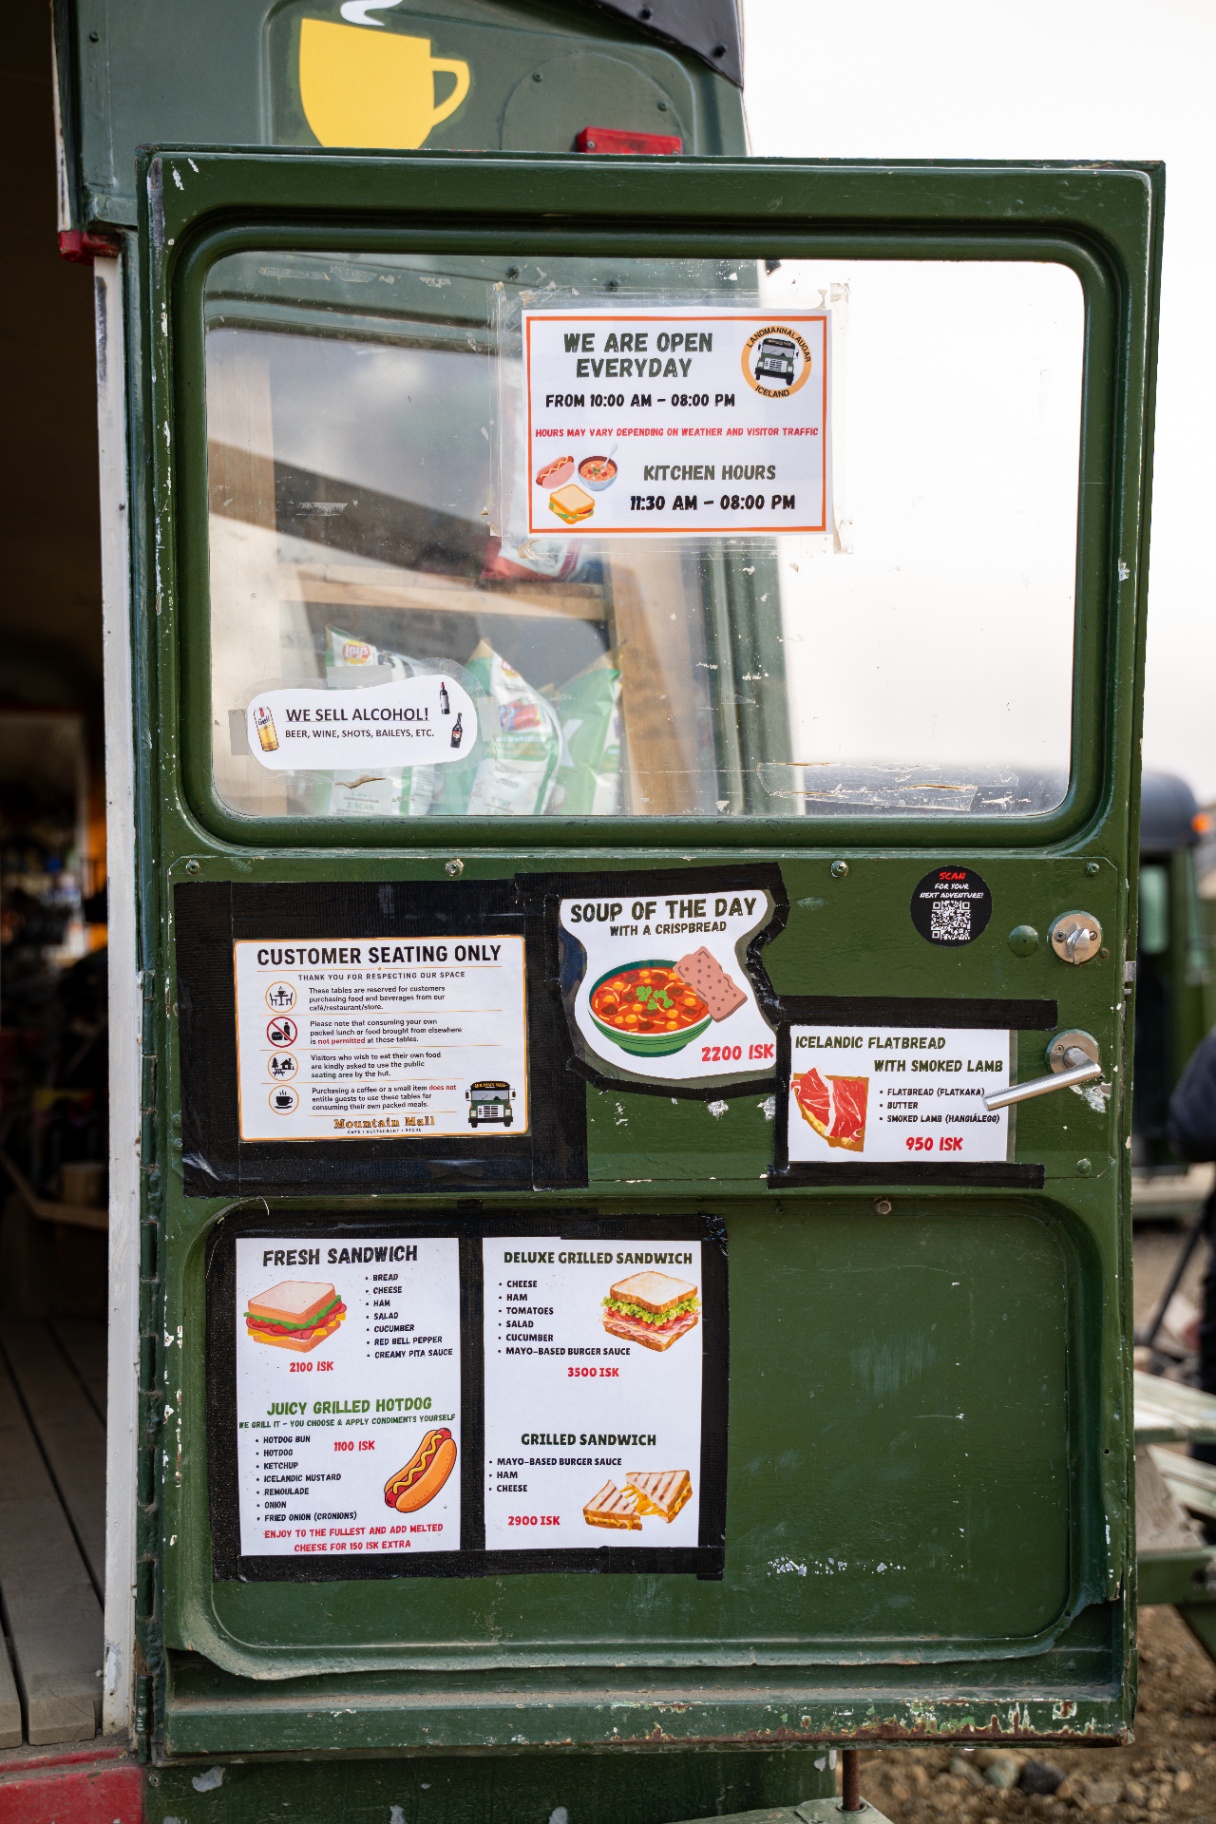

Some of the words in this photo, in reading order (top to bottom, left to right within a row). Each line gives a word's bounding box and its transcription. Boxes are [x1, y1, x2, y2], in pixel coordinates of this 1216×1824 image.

[564, 333, 595, 353] WE
[604, 333, 648, 352] ARE
[657, 333, 713, 352] OPEN
[747, 326, 811, 363] LANDMANNALAUGAR
[576, 358, 692, 378] EVERYDAY
[755, 385, 790, 398] ICELAND
[546, 394, 585, 408] FROM
[590, 394, 625, 407] 10:00
[630, 394, 652, 407] AM
[671, 394, 709, 407] 08:00
[715, 394, 735, 407] PM
[535, 429, 564, 437] HOURS
[567, 429, 586, 437] MAY
[590, 428, 613, 436] VARY
[616, 428, 664, 436] DEPENDING
[667, 428, 679, 436] ON
[682, 428, 723, 436] WEATHER
[726, 428, 744, 436] AND
[747, 428, 779, 436] VISITOR
[782, 427, 819, 436] TRAFFIC
[644, 465, 715, 481] KITCHEN
[722, 465, 776, 480] HOURS
[631, 496, 666, 510] 11:30
[672, 495, 697, 510] AM
[720, 495, 765, 510] 08:00
[771, 495, 795, 510] PM
[286, 709, 311, 722] WE
[316, 709, 348, 722] SELL
[352, 708, 428, 721] ALCOHOL!
[286, 730, 310, 739] BEER,
[312, 730, 340, 738] WINE,
[342, 730, 373, 738] SHOTS,
[376, 729, 413, 737] BAILEYS,
[416, 729, 434, 737] ETC.
[939, 872, 966, 880] SCAN
[571, 903, 623, 923] SOUP
[632, 901, 657, 920] OF
[665, 899, 706, 919] THE
[715, 898, 757, 917] DAY
[610, 925, 638, 936] WITH
[643, 925, 651, 935] A
[655, 921, 727, 934] CRISPBREAD
[257, 948, 361, 965] CUSTOMER
[368, 946, 448, 963] SEATING
[455, 945, 501, 962] ONLY
[366, 972, 417, 980] RESPECTING
[796, 1036, 863, 1048] ICELANDIC
[868, 1037, 946, 1049] FLATBREAD
[702, 1046, 742, 1062] 2200
[749, 1044, 774, 1060] ISK
[874, 1060, 906, 1072] WITH
[911, 1060, 963, 1072] SMOKED
[967, 1060, 1003, 1072] LAMB
[887, 1088, 934, 1096] FLATBREAD
[937, 1088, 985, 1097] (FLATKAKA)
[334, 1118, 400, 1129] Mountain
[405, 1116, 435, 1126] Mall
[920, 1115, 942, 1123] LAMB
[906, 1137, 934, 1151] 950
[939, 1137, 963, 1151] ISK
[263, 1249, 320, 1266] FRESH
[328, 1245, 418, 1264] SANDWICH
[504, 1252, 555, 1264] DELUXE
[558, 1252, 613, 1264] GRILLED
[616, 1253, 692, 1264] SANDWICH
[373, 1286, 402, 1294] CHEESE
[374, 1312, 399, 1320] SALAD
[506, 1307, 554, 1315] TOMATOES
[374, 1324, 415, 1332] CUCUMBER
[374, 1338, 389, 1346] RED
[392, 1337, 410, 1345] BELL
[413, 1336, 442, 1344] PEPPER
[375, 1351, 406, 1359] CREAMY
[428, 1348, 453, 1356] SAUCE
[290, 1362, 313, 1372] 2100
[317, 1361, 334, 1372] ISK
[568, 1367, 597, 1377] 3500
[599, 1368, 619, 1377] ISK
[267, 1402, 307, 1416] JUICY
[313, 1400, 370, 1414] GRILLED
[376, 1397, 432, 1412] HOTDOG
[306, 1419, 335, 1427] CHOOSE
[345, 1418, 369, 1426] APPLY
[372, 1416, 417, 1424] CONDIMENTS
[420, 1414, 456, 1422] YOURSELF
[263, 1436, 293, 1444] HOTDOG
[334, 1441, 354, 1451] 1100
[358, 1440, 375, 1451] ISK
[521, 1434, 576, 1446] GRILLED
[579, 1434, 656, 1446] SANDWICH
[264, 1449, 293, 1457] HOTDOG
[264, 1462, 298, 1470] KETCHUP
[264, 1475, 303, 1483] ICELANDIC
[306, 1474, 342, 1482] MUSTARD
[264, 1488, 309, 1496] REMOULADE
[265, 1501, 287, 1509] ONION
[265, 1514, 287, 1522] FRIED
[289, 1513, 311, 1521] ONION
[314, 1512, 357, 1521] (CRONIONS)
[508, 1516, 538, 1526] 2900
[540, 1516, 560, 1526] ISK
[264, 1530, 292, 1539] ENJOY
[295, 1529, 307, 1538] TO
[310, 1528, 326, 1537] THE
[329, 1527, 366, 1536] FULLEST
[369, 1526, 387, 1535] AND
[390, 1525, 407, 1534] ADD
[410, 1524, 443, 1533] MELTED
[294, 1543, 328, 1552] CHEESE
[330, 1542, 347, 1551] FOR
[350, 1542, 363, 1550] 150
[366, 1542, 379, 1550] ISK
[382, 1540, 411, 1549] EXTRA
